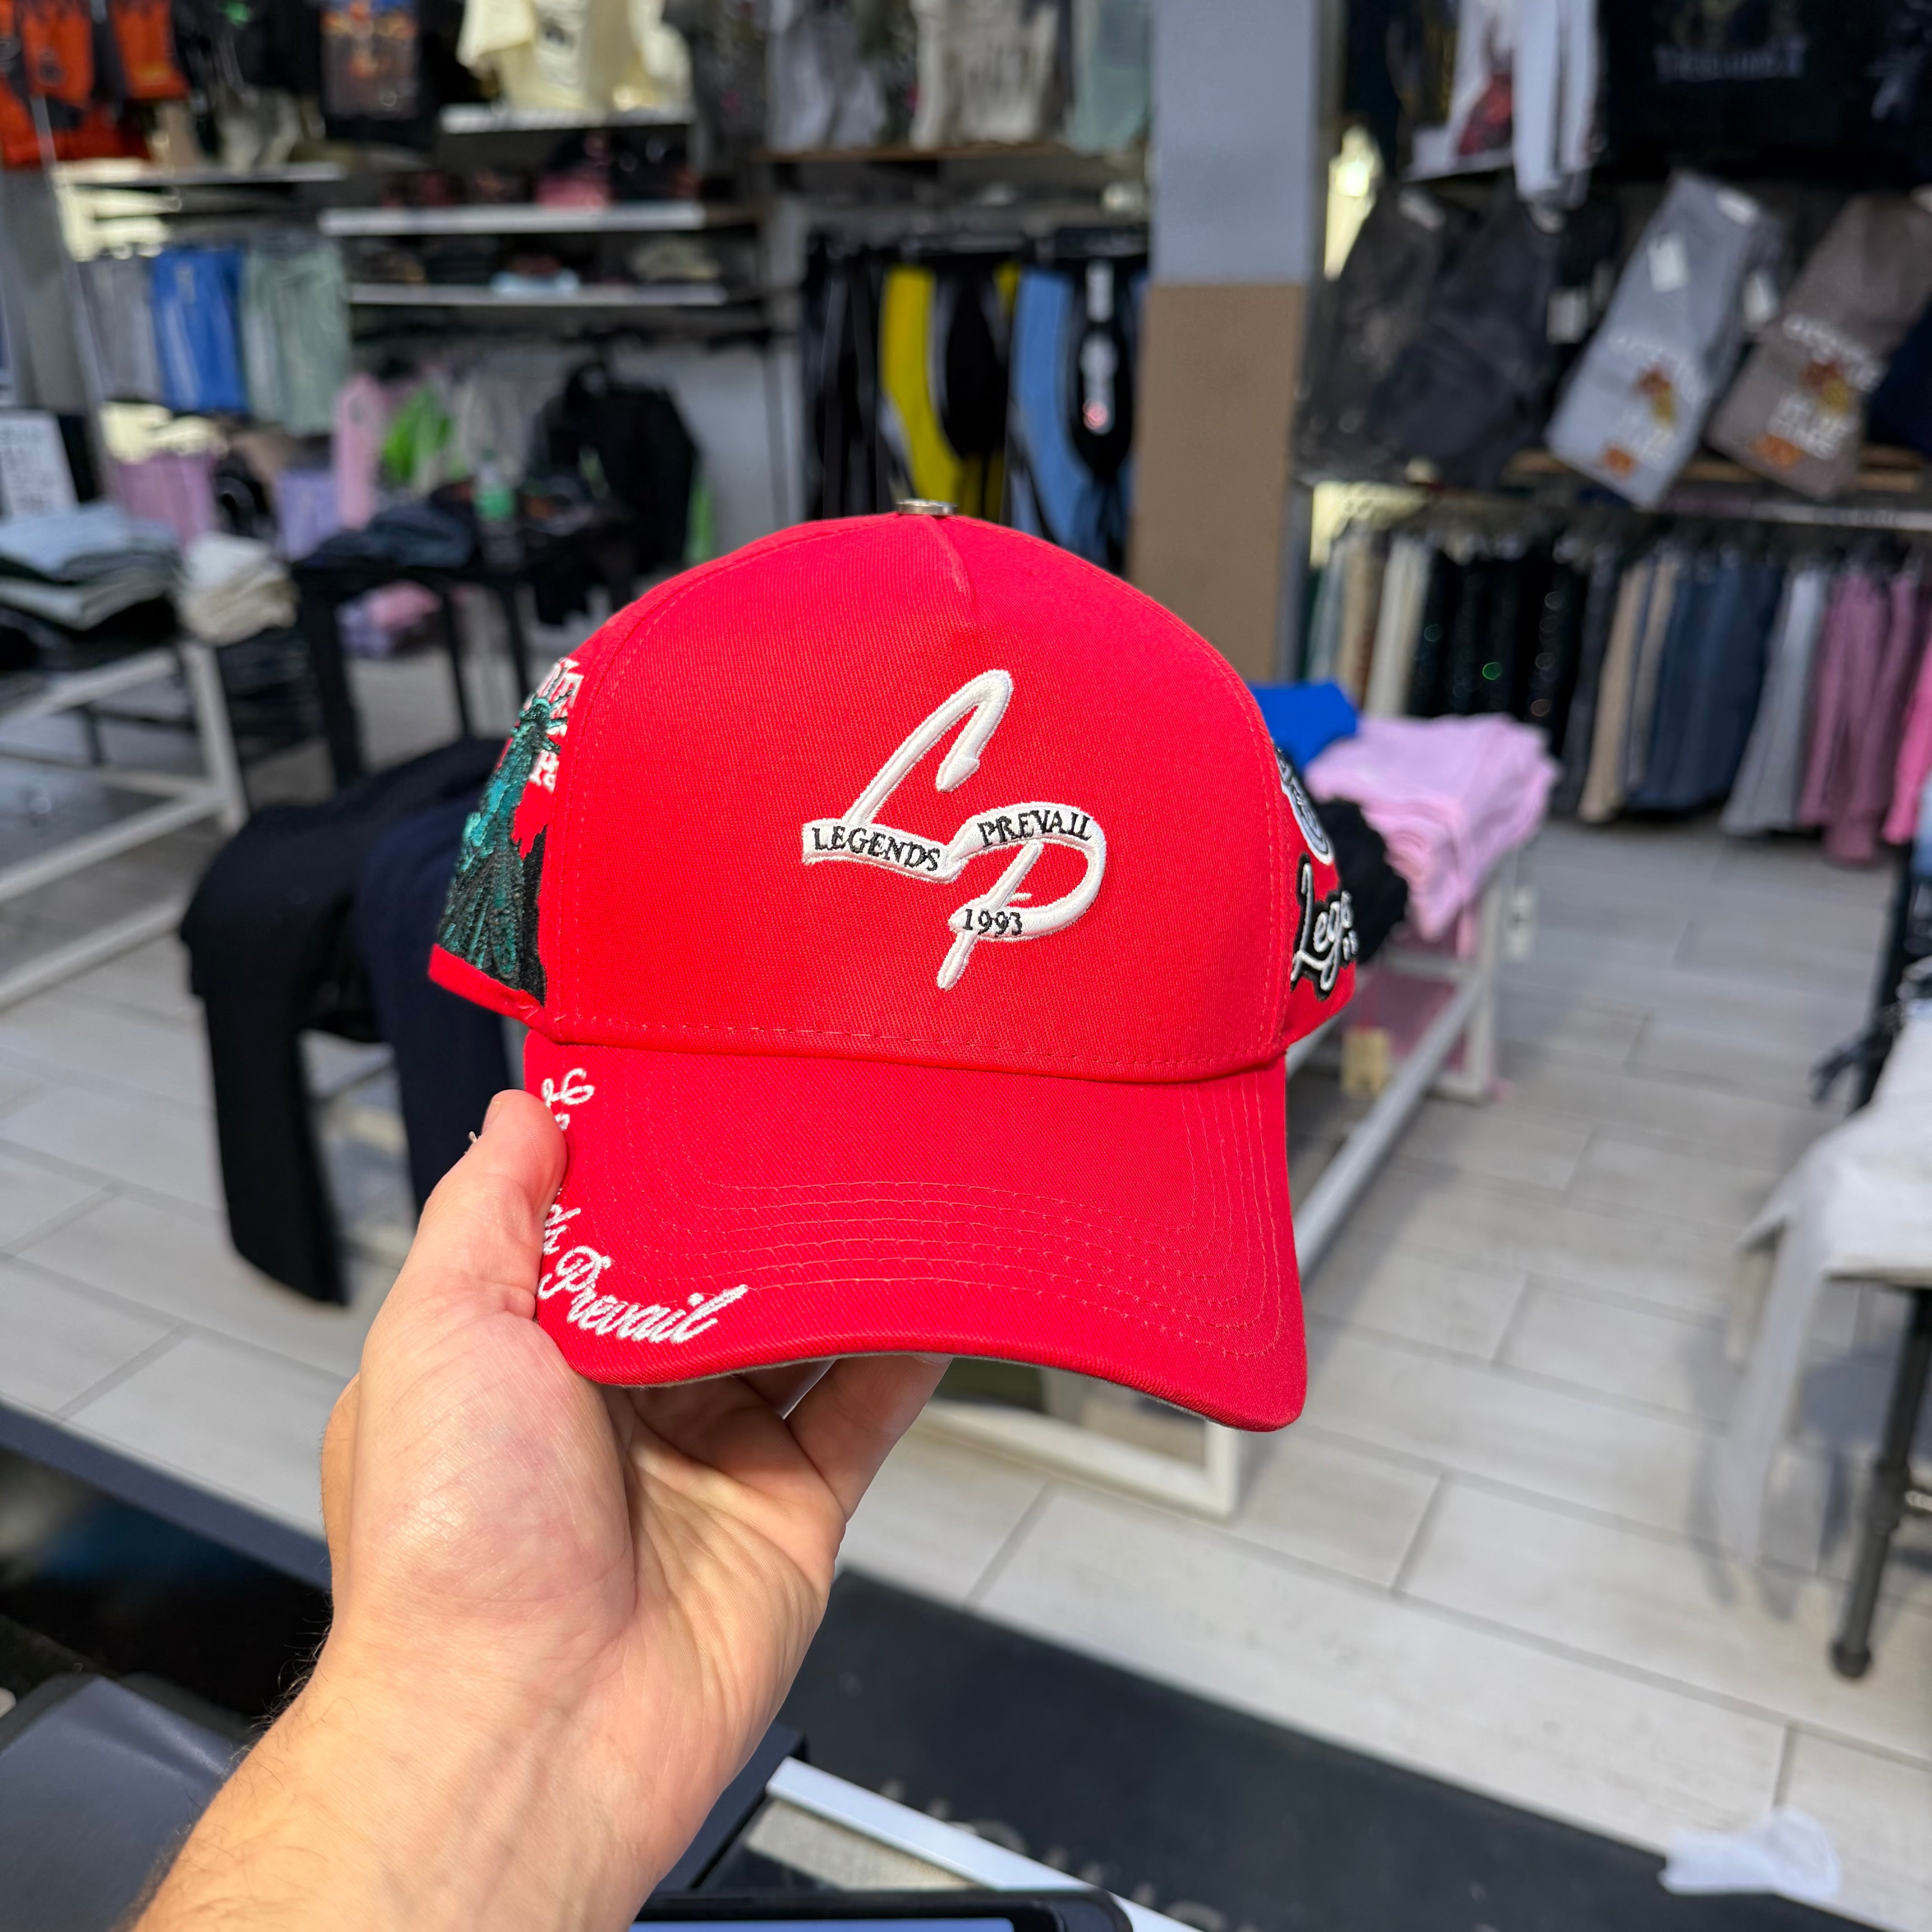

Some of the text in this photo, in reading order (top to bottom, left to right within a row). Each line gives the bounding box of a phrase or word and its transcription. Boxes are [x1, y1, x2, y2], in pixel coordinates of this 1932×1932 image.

[811, 809, 1093, 872] LEGENDS PREVAIL
[962, 907, 1024, 938] 1993
[538, 1245, 749, 1344] Prevail
